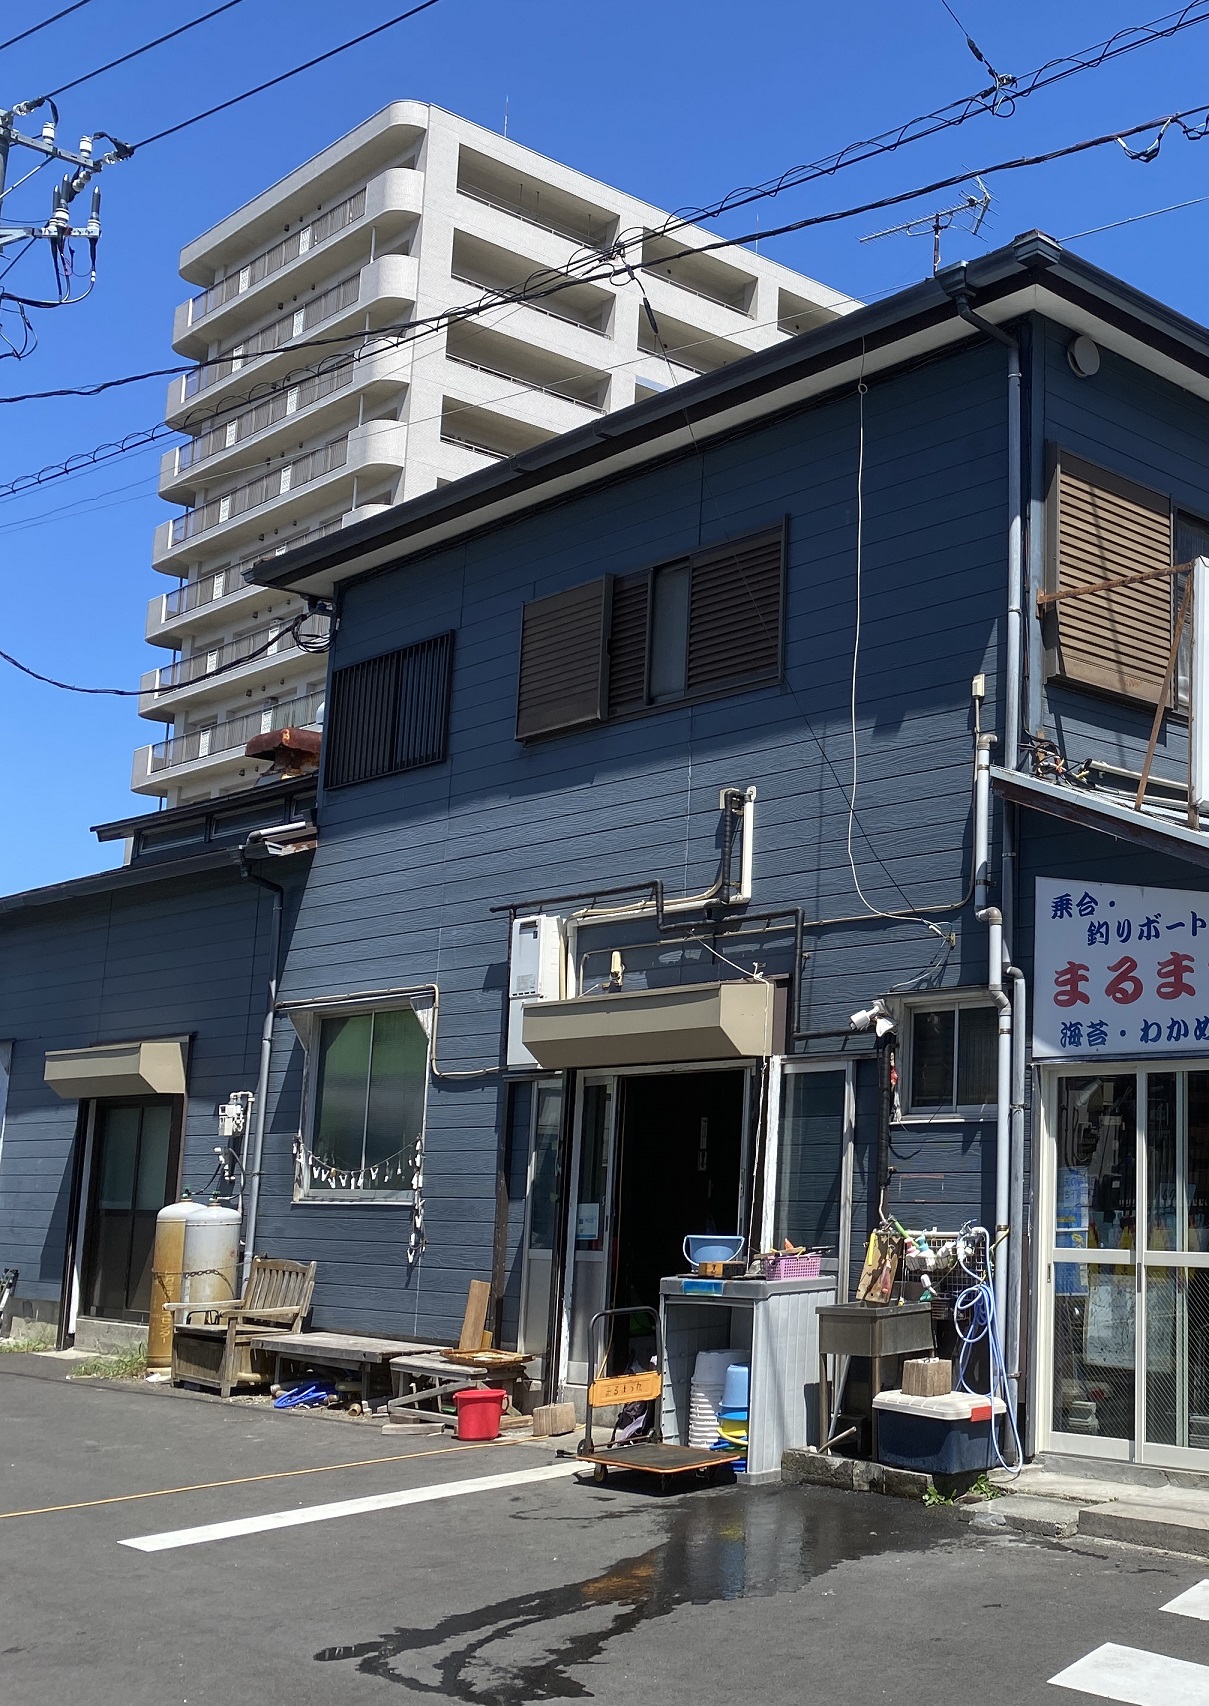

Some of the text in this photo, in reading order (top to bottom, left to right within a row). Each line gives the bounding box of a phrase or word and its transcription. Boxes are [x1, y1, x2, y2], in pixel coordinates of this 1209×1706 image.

[1087, 911, 1208, 946] 釣りボート
